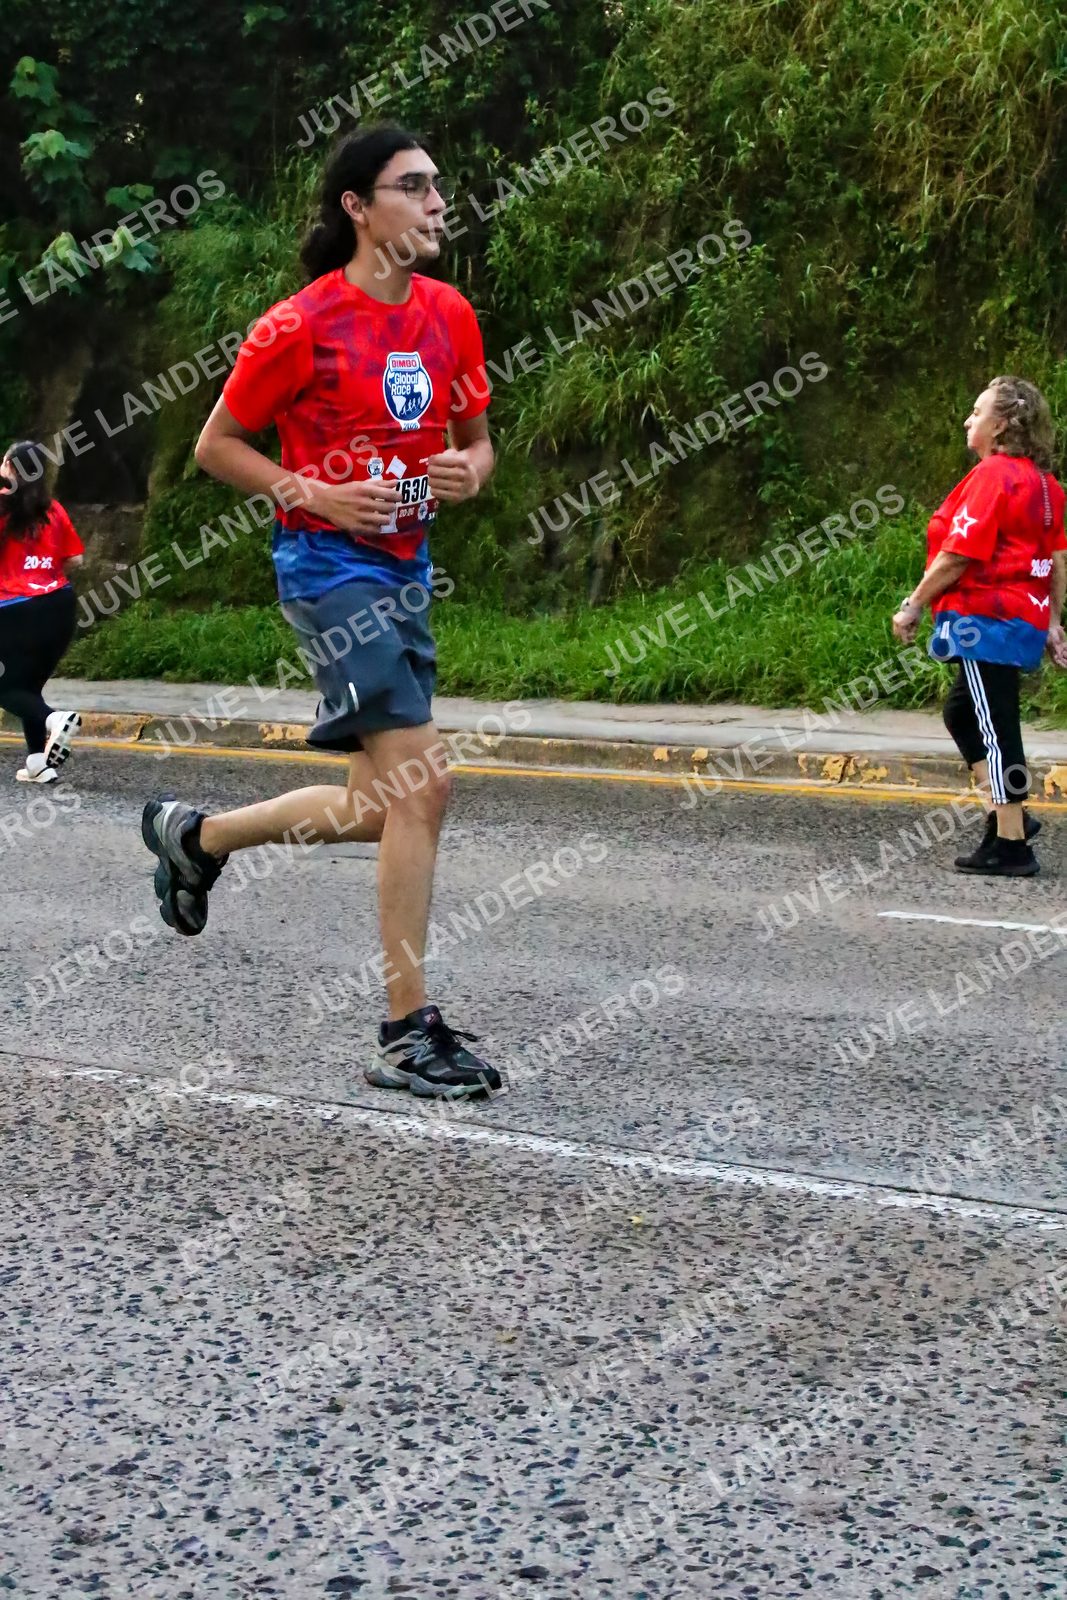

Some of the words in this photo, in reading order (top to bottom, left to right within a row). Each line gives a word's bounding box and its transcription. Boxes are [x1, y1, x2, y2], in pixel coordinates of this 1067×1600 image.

[391, 359, 417, 368] BIMBO
[394, 372, 418, 385] Global
[391, 384, 411, 396] Race
